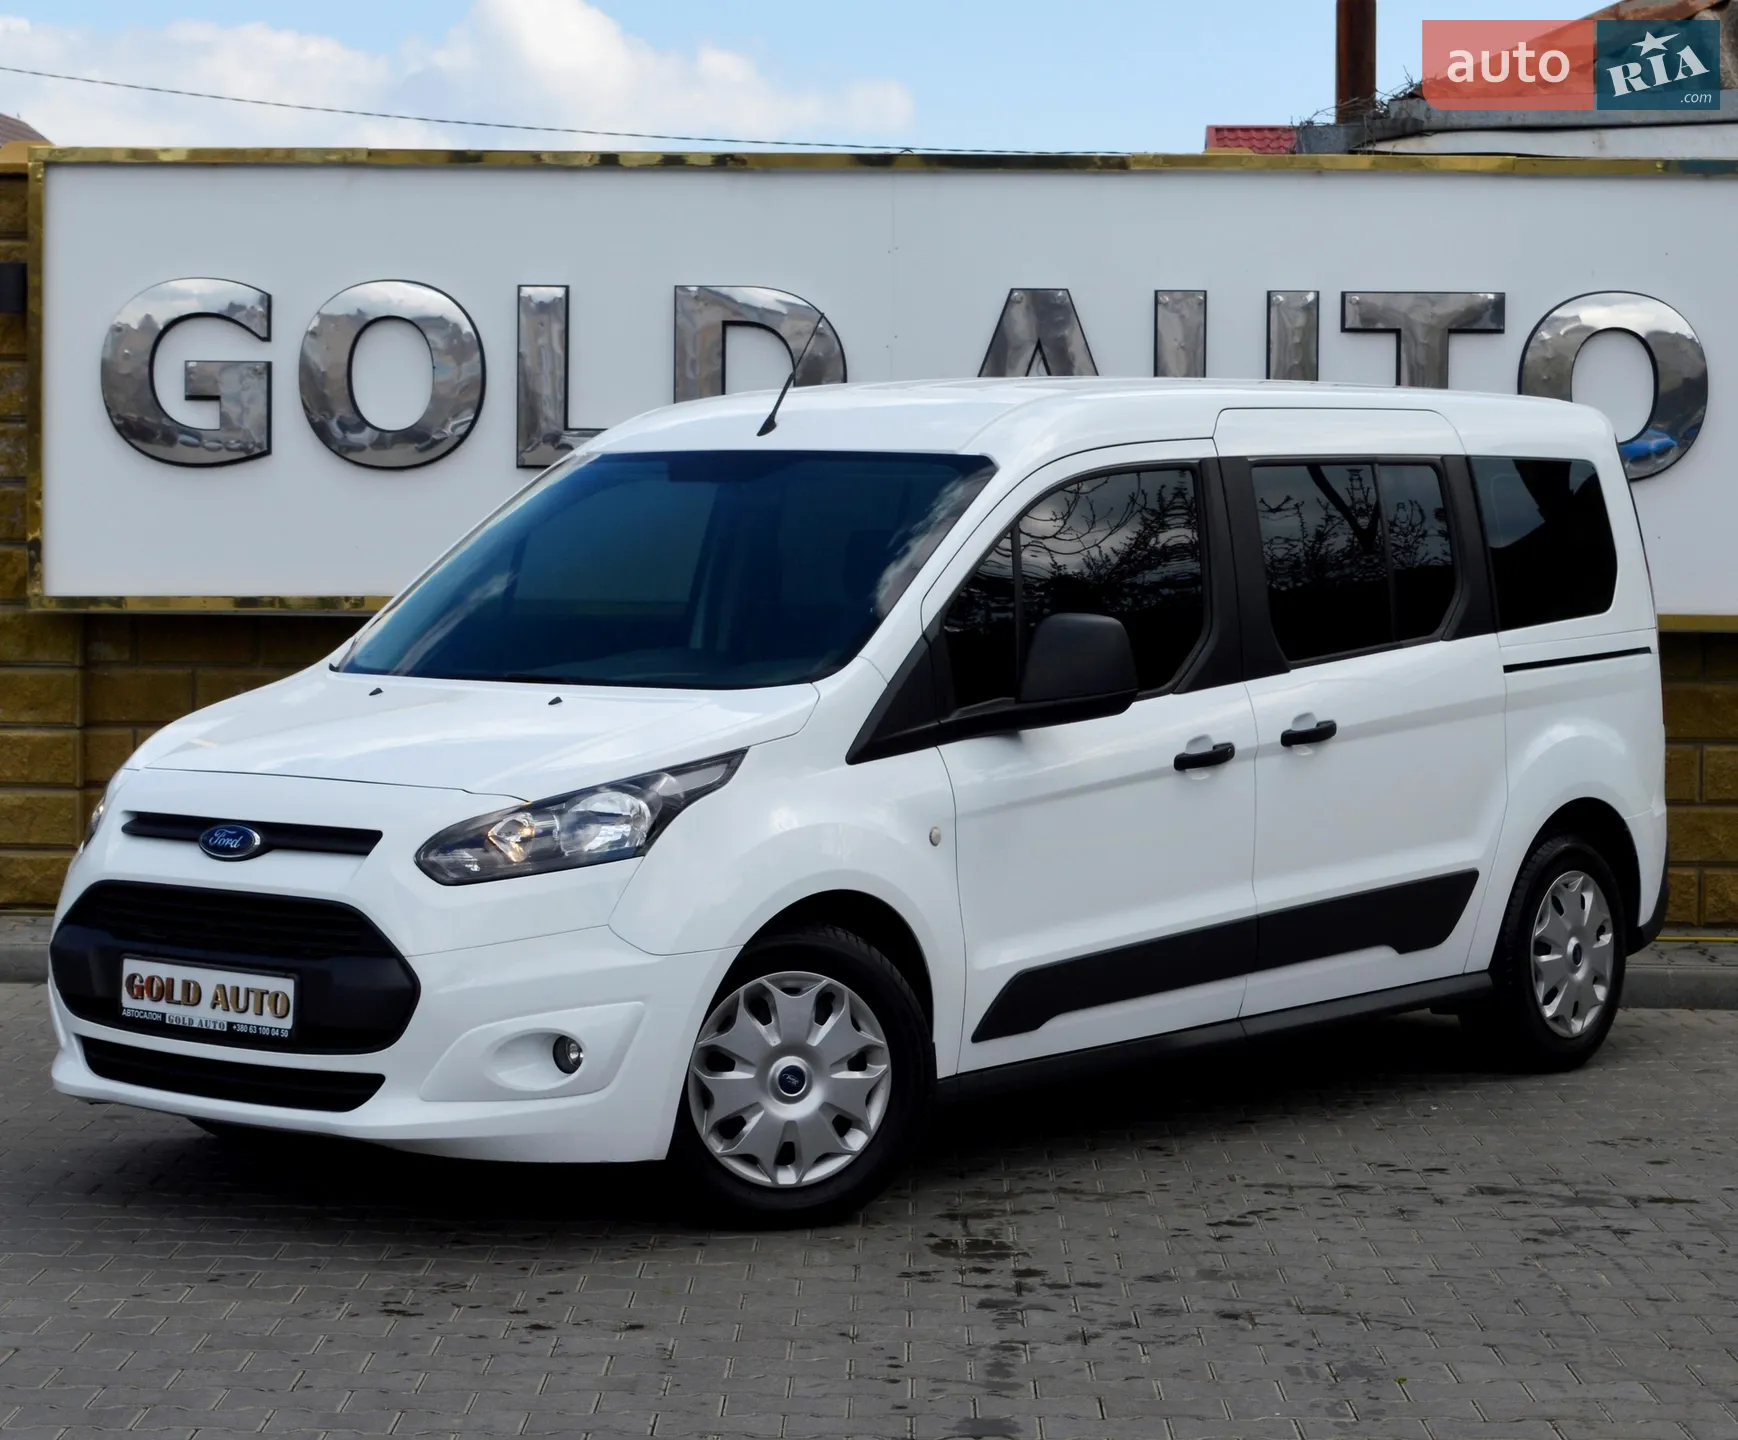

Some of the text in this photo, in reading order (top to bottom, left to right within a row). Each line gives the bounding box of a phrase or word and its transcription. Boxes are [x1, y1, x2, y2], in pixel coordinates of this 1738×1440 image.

[101, 277, 847, 469] GOLD
[209, 828, 244, 848] Ford
[125, 972, 291, 1019] GOLD AUTO
[121, 1008, 289, 1038] АВТОСАЛОН GOLD AUTO +380 63 100 04 50
